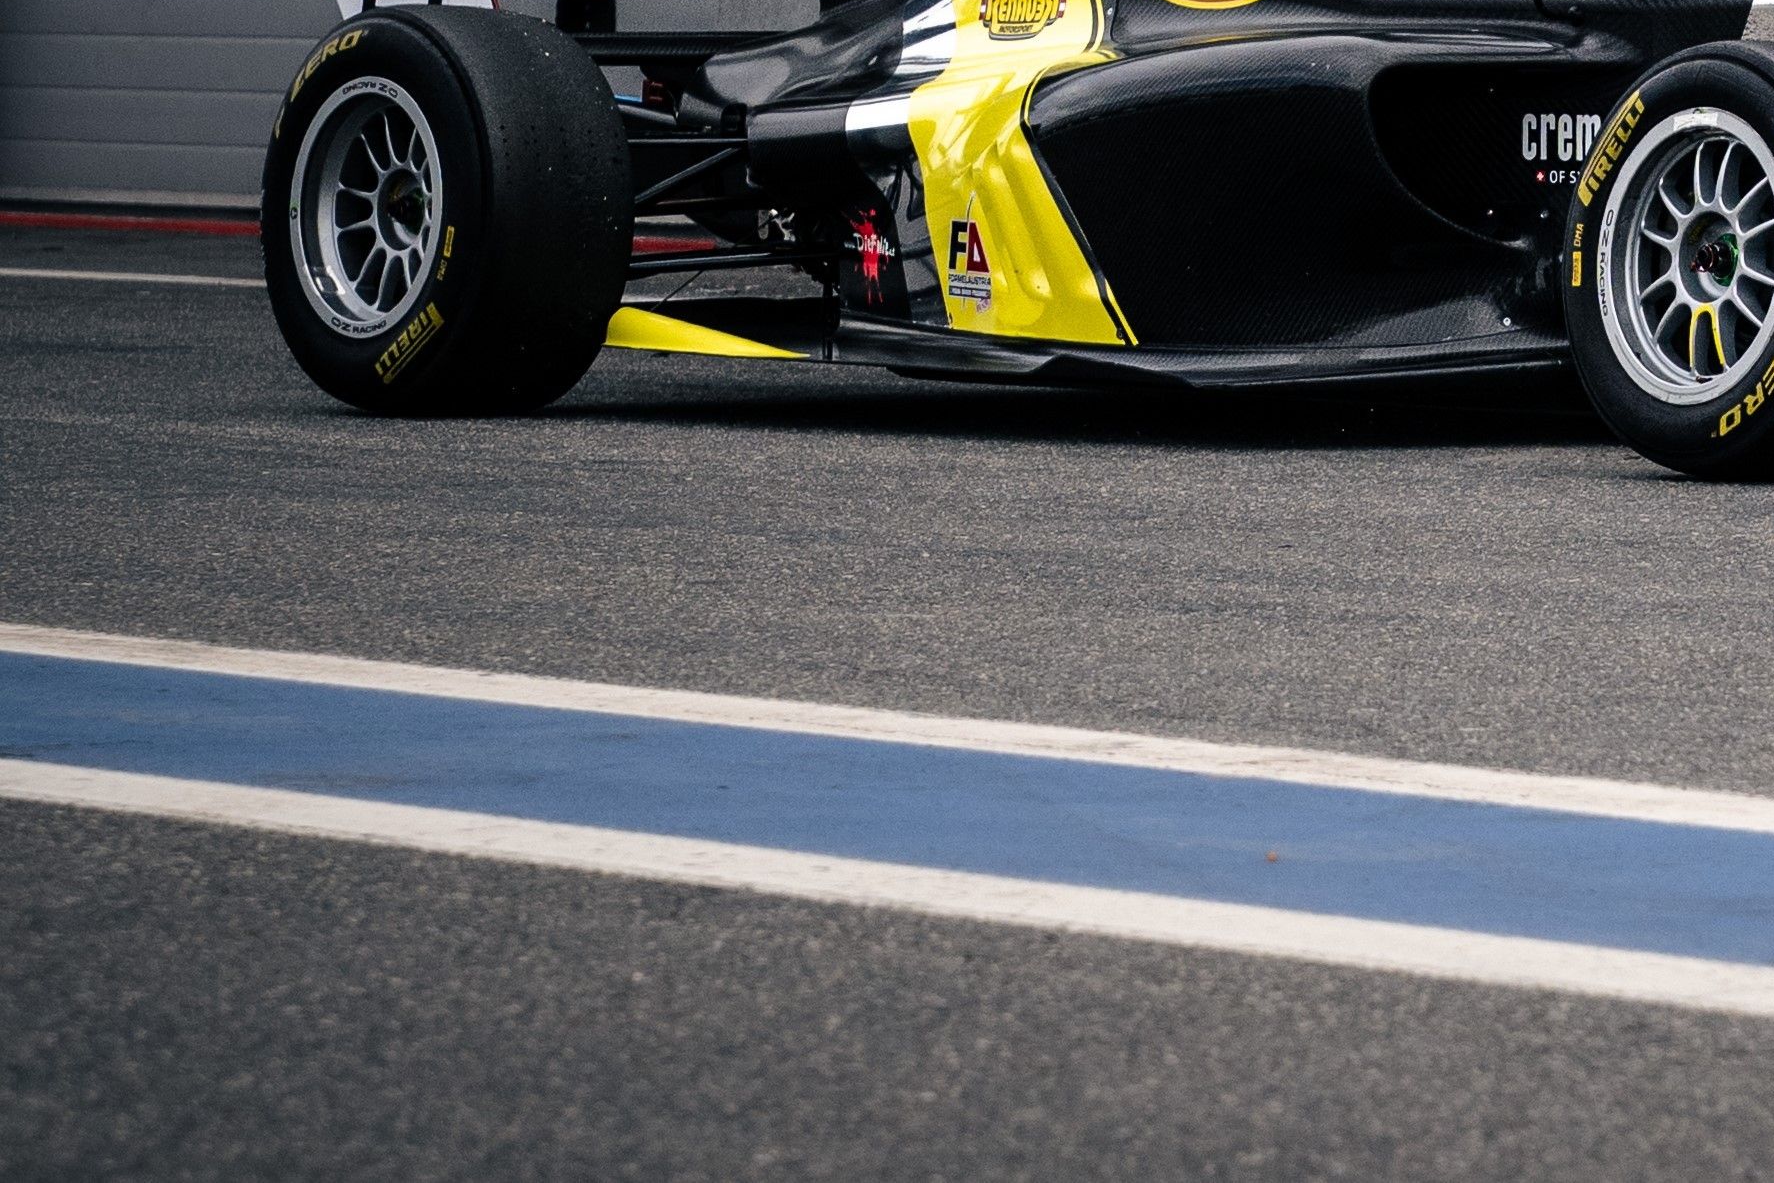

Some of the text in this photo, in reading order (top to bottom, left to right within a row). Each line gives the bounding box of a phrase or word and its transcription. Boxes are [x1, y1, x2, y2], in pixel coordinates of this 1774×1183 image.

[1577, 89, 1645, 207] PIRELLI
[1549, 170, 1566, 184] OF
[1573, 223, 1585, 247] DMA
[331, 317, 387, 334] OZ RACING
[374, 301, 445, 385] PIRELLI
